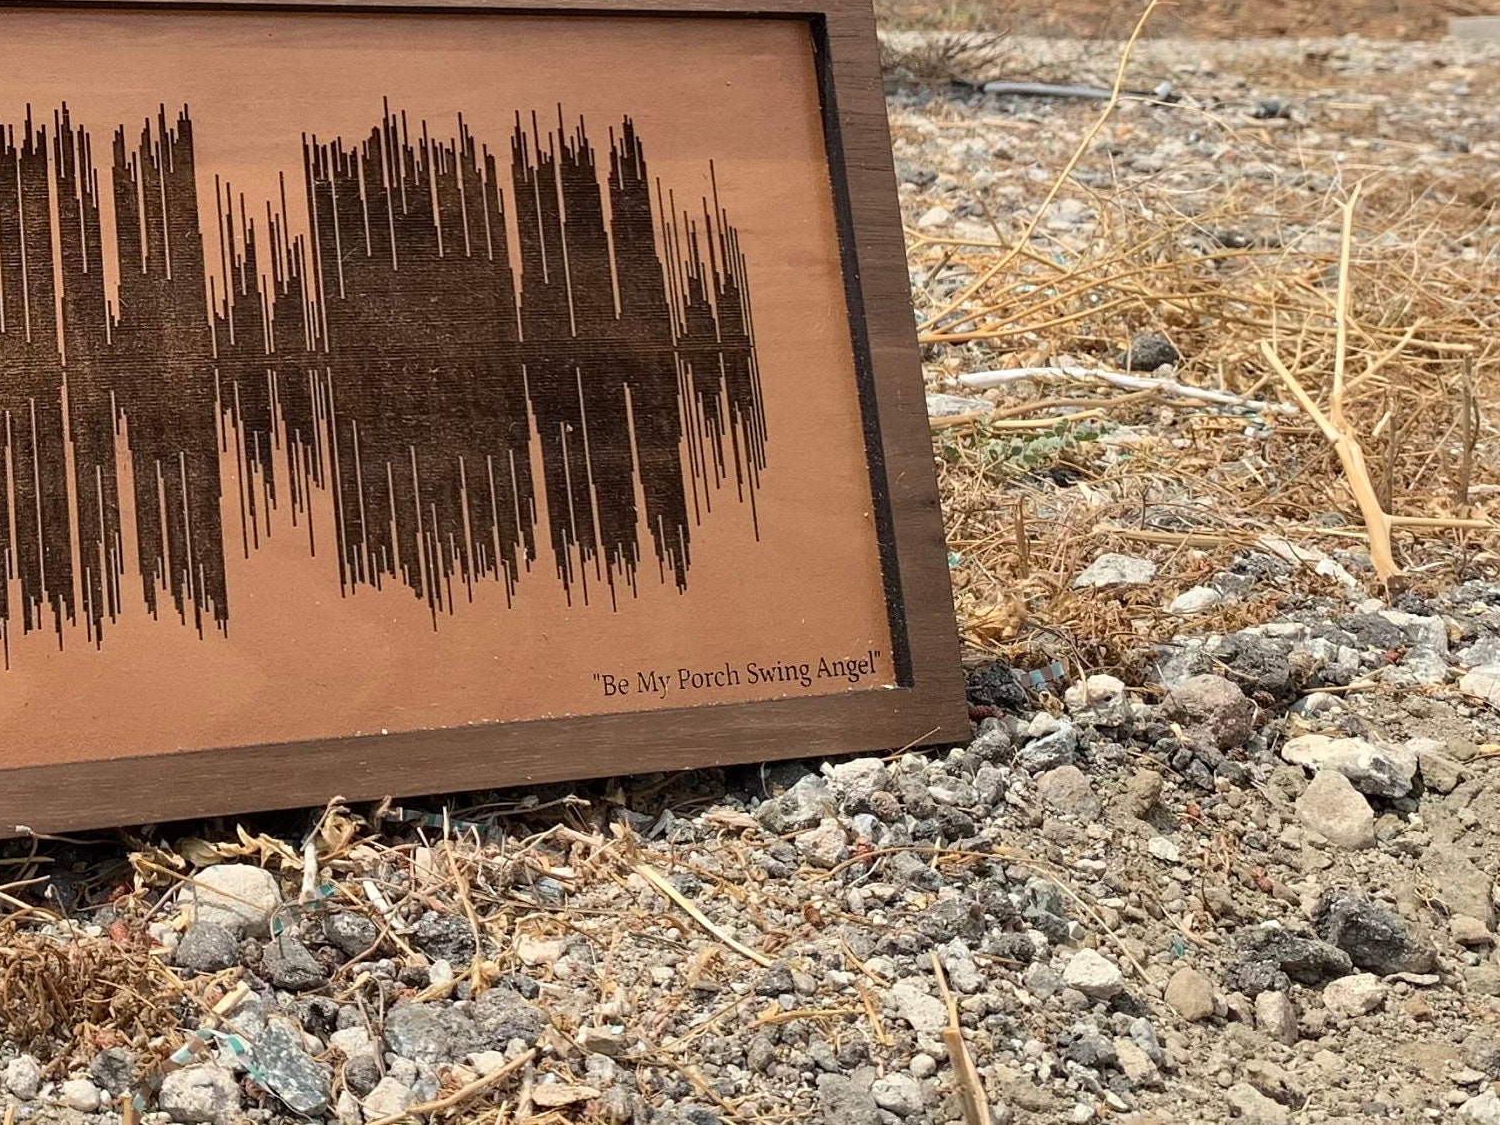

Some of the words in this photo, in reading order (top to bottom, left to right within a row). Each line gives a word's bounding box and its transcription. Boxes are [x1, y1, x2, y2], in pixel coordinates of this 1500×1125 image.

[593, 673, 629, 697] "Be
[637, 671, 670, 699] My
[678, 663, 741, 691] Porch
[746, 660, 811, 687] Swing
[817, 650, 881, 683] Angel"
